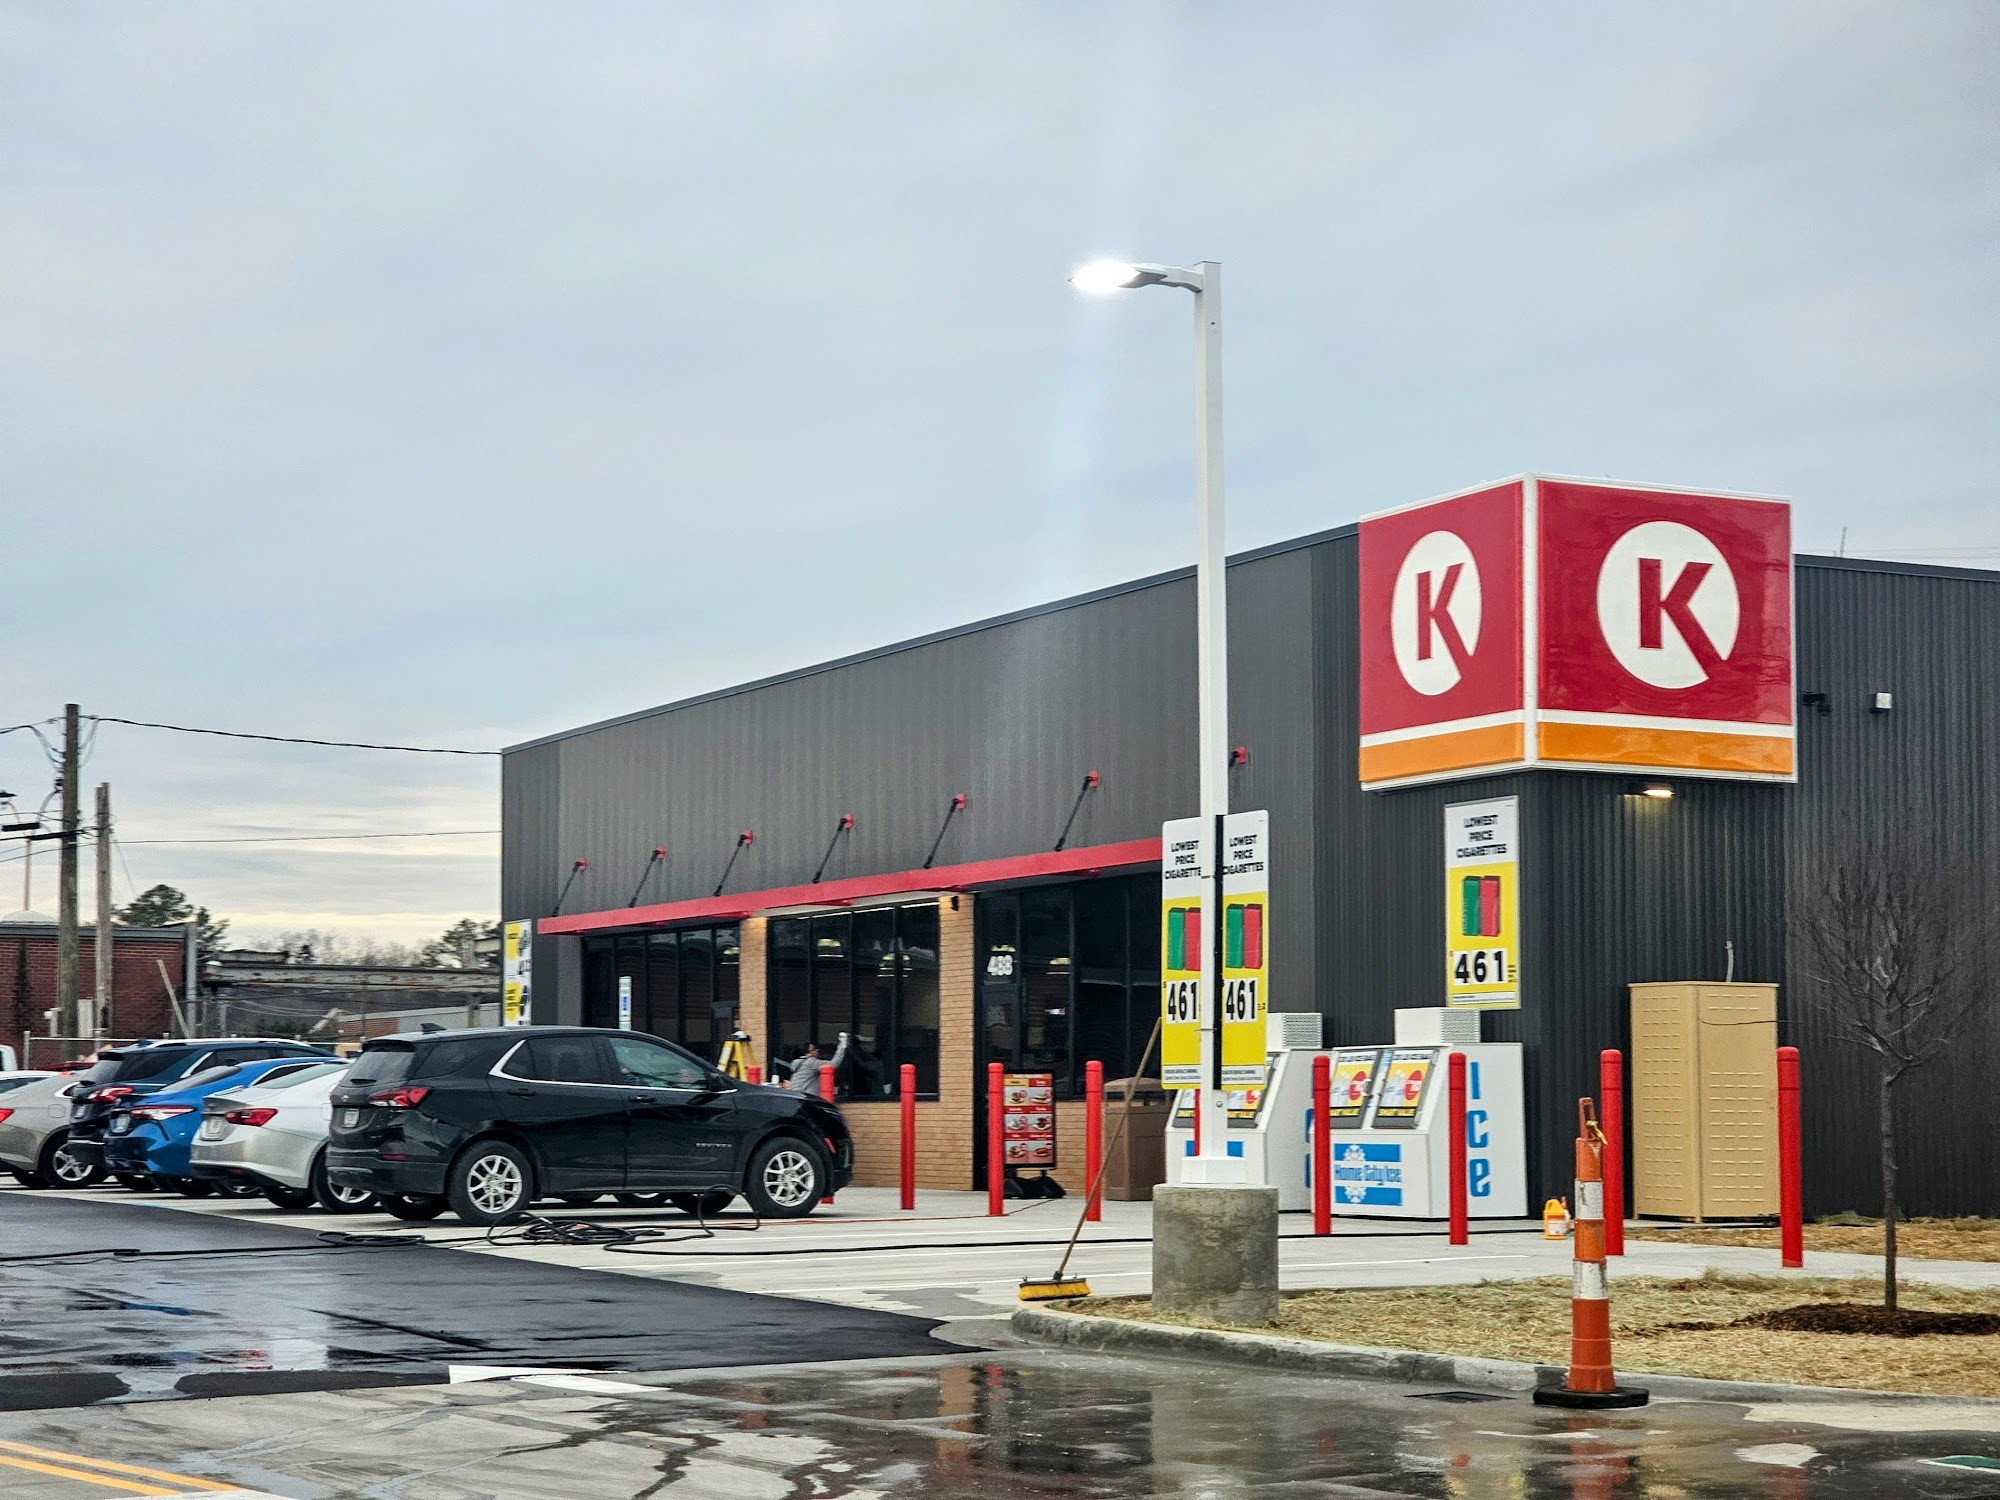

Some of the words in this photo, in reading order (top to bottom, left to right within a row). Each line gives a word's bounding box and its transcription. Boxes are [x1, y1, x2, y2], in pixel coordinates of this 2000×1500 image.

[1416, 562, 1475, 679] K
[1638, 557, 1726, 679] K
[1463, 814, 1499, 829] LOWEST
[1229, 834, 1258, 848] LOWEST
[1468, 829, 1494, 842] PRICE
[1171, 840, 1199, 852] LOWEST
[1456, 843, 1507, 858] CIGARETTES
[1175, 854, 1195, 865] PRICE
[1233, 849, 1253, 861] PRICE
[1165, 866, 1202, 879] CIGARETTE
[1222, 861, 1264, 875] CIGARETTES
[1455, 951, 1503, 983] 461
[1168, 982, 1197, 1021] 461
[1226, 980, 1256, 1020] 461
[1467, 1061, 1491, 1197] Ice
